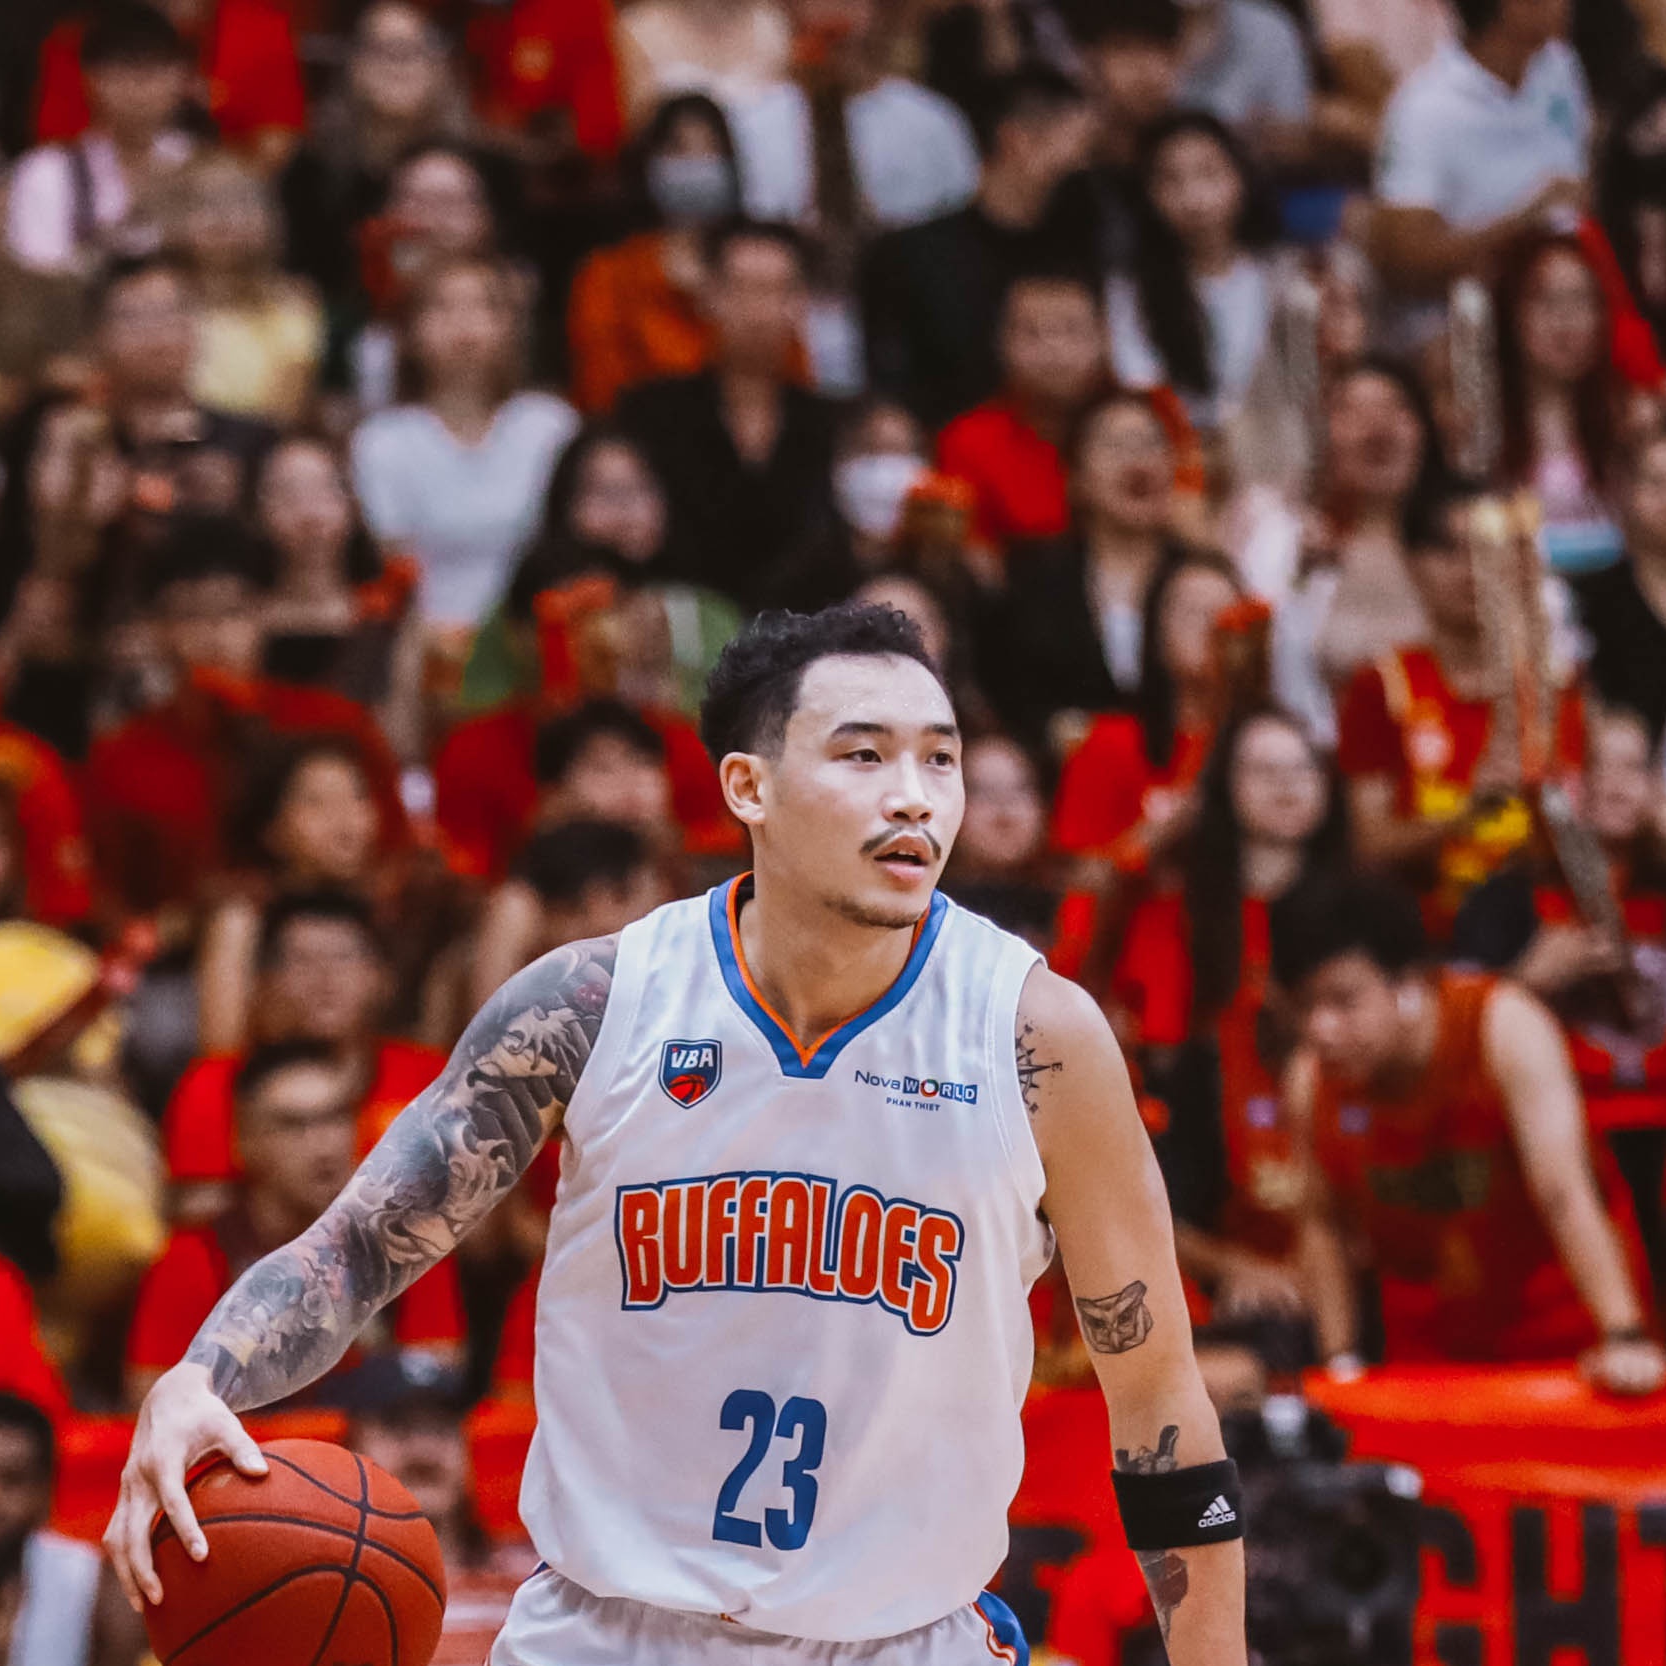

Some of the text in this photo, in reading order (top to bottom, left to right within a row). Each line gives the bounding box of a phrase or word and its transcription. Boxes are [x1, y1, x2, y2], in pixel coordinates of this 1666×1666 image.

[671, 1047, 714, 1068] VBA
[886, 1096, 912, 1108] PHAN
[614, 1170, 965, 1337] BUFFALOES
[712, 1388, 828, 1551] 23
[1198, 1511, 1237, 1528] adidas
